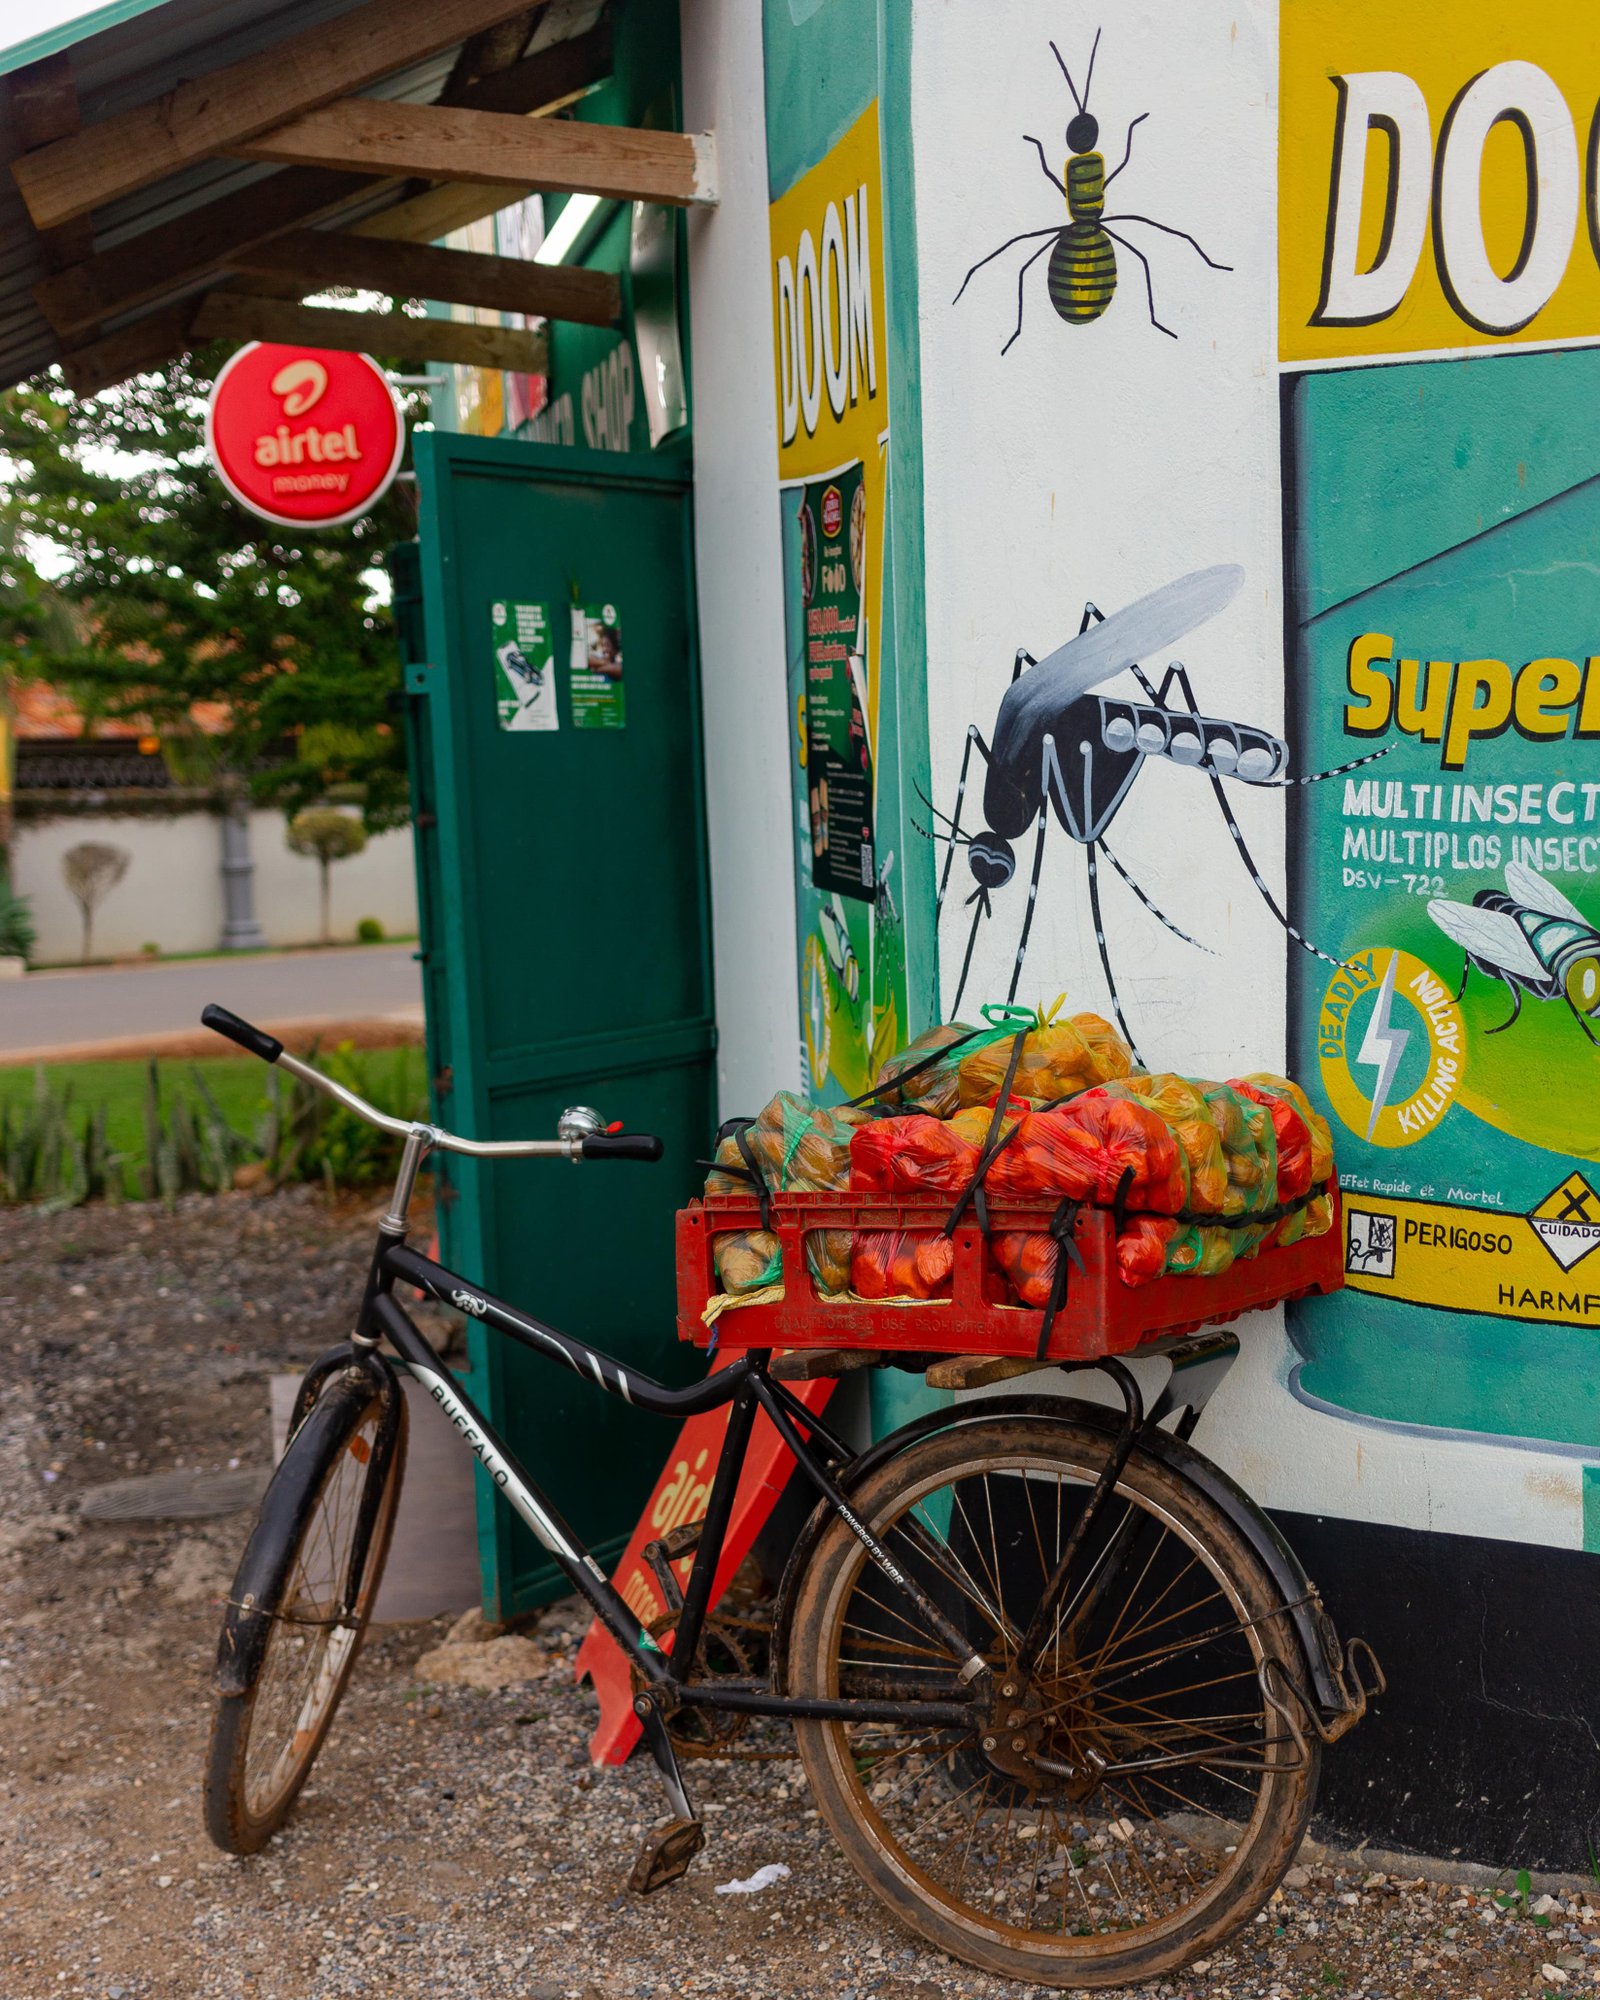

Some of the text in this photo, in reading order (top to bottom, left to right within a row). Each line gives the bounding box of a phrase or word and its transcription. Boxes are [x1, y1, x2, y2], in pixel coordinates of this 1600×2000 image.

[1306, 60, 1600, 337] DO
[776, 183, 876, 449] DOOM
[254, 424, 362, 467] airtel
[273, 473, 349, 493] money
[1342, 779, 1442, 820] MULTI
[1342, 826, 1600, 873] MULTIPLOS INSEC
[1342, 868, 1449, 896] DSV-722
[1319, 952, 1377, 1059] DEADLY
[1397, 970, 1460, 1134] KILLING ACTION
[1373, 1178, 1411, 1195] Rapide
[1419, 1184, 1435, 1197] et
[1446, 1187, 1504, 1206] Mortel
[1404, 1218, 1512, 1254] PERIGOSO
[774, 1314, 995, 1334] UNAUTHORISED USE PROHIBITED
[429, 1384, 509, 1488] BUFFALO
[837, 1504, 905, 1585] POWERED BY WBR
